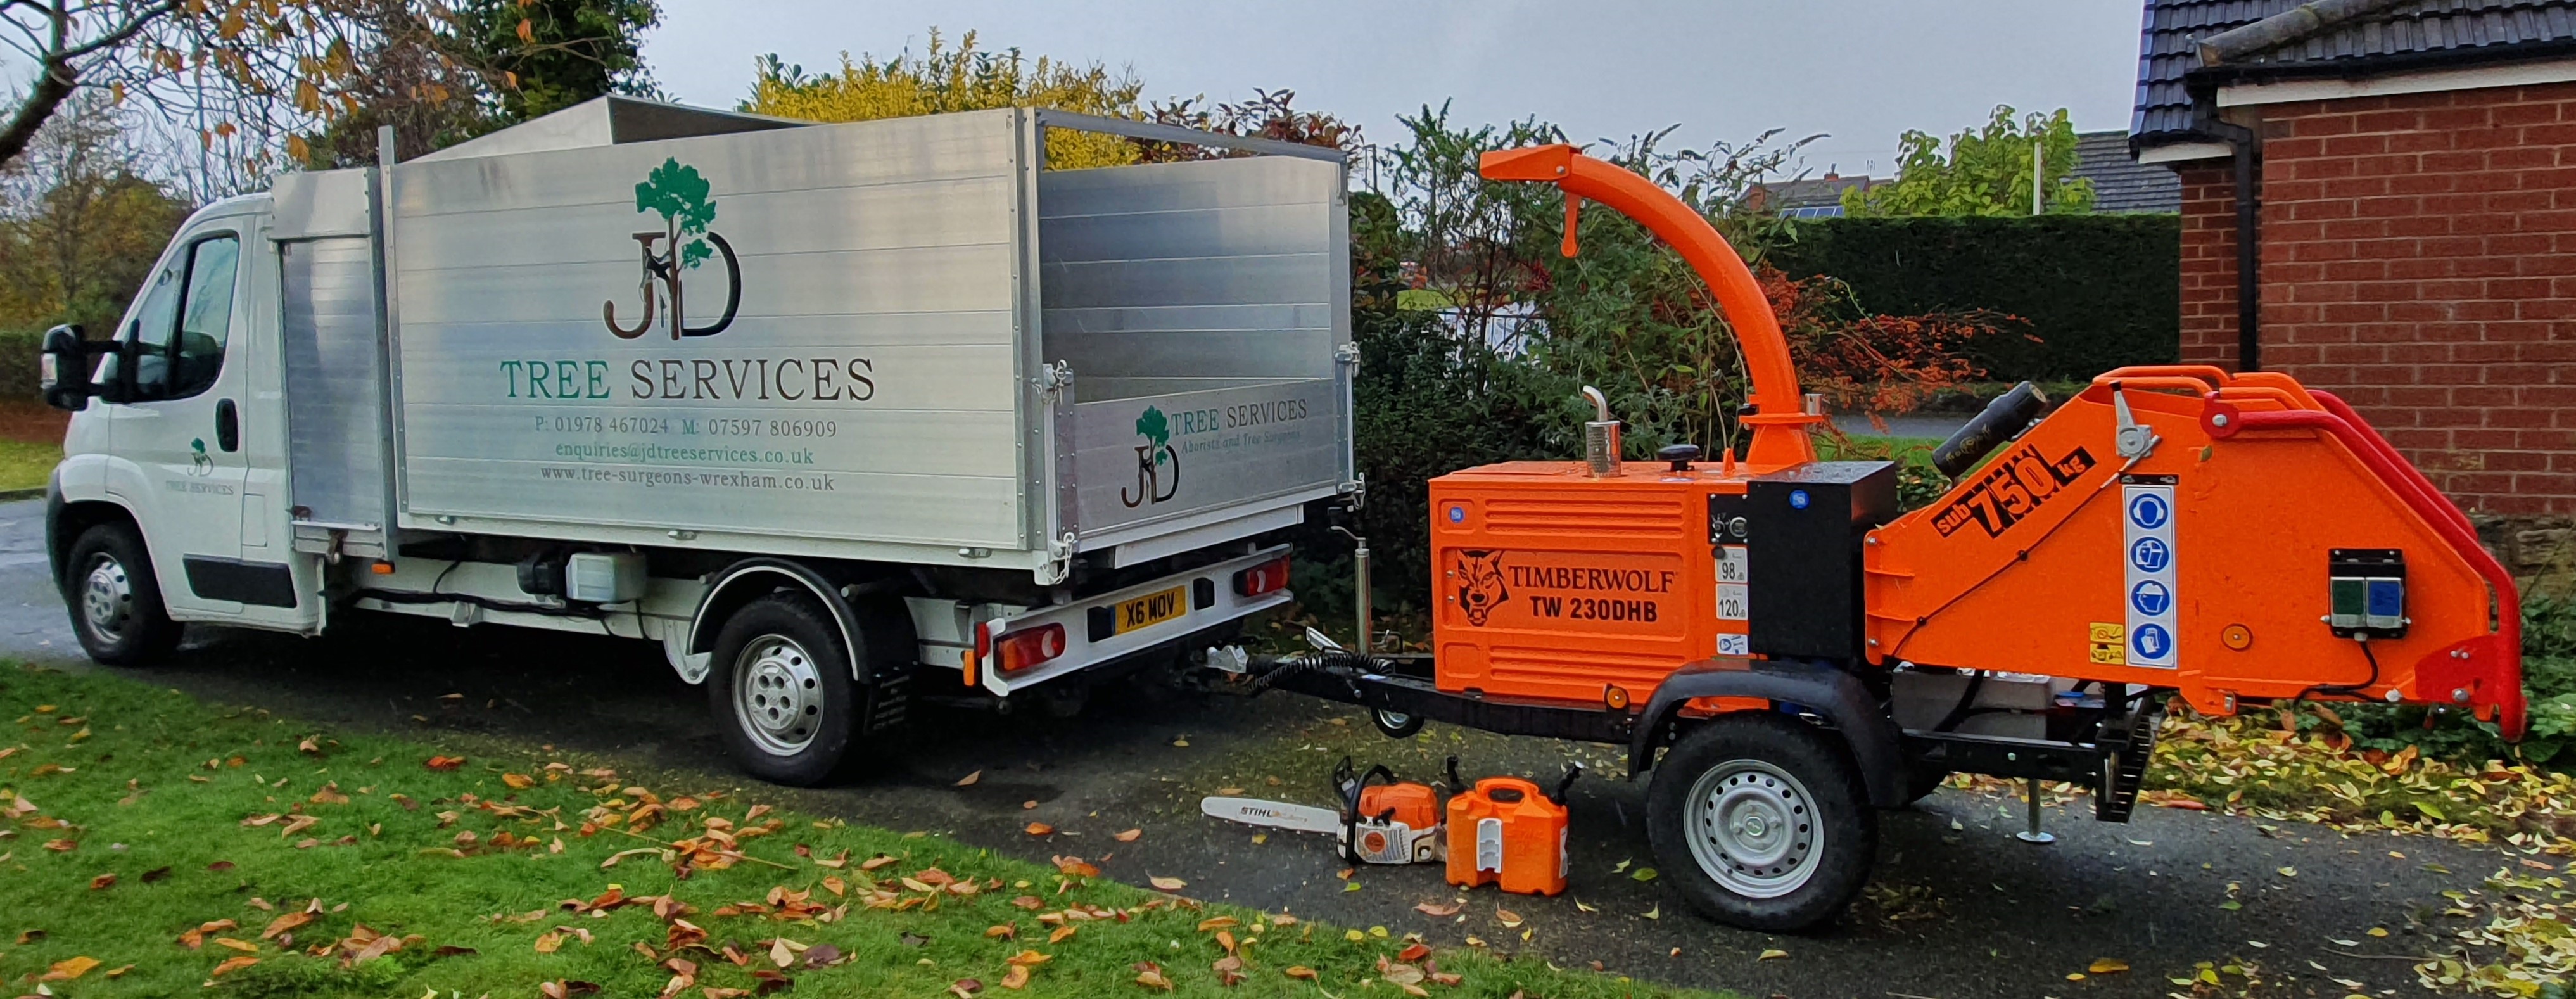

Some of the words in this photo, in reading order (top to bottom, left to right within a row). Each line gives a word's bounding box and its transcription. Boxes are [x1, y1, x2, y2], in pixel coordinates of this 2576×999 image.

[499, 359, 611, 399] TREE
[631, 358, 875, 402] SERVICES
[535, 416, 549, 431] P:
[555, 416, 603, 433] 01978
[609, 417, 669, 434] 467024
[682, 419, 699, 435] M:
[708, 419, 762, 436] 07597
[769, 420, 837, 438] 806909
[1171, 409, 1220, 436] TREE
[1226, 398, 1307, 429] SERVICES
[555, 442, 815, 464] enquiries@jdtreeservices.co.uk
[1222, 433, 1240, 448] and
[1243, 432, 1261, 446] Tree
[540, 466, 835, 492] www.tree-surgeons-wrexham.co.uk
[1936, 503, 1971, 534] sub
[1967, 456, 2056, 533] 750
[2057, 455, 2086, 478] kg
[1507, 565, 1675, 594] TIMBERWOLF
[1722, 562, 1735, 580] 98
[1126, 600, 1145, 629] X6
[1528, 595, 1563, 618] TW
[1569, 597, 1658, 623] 230DHB
[1718, 598, 1739, 617] 120
[1241, 806, 1273, 818] STIHL
